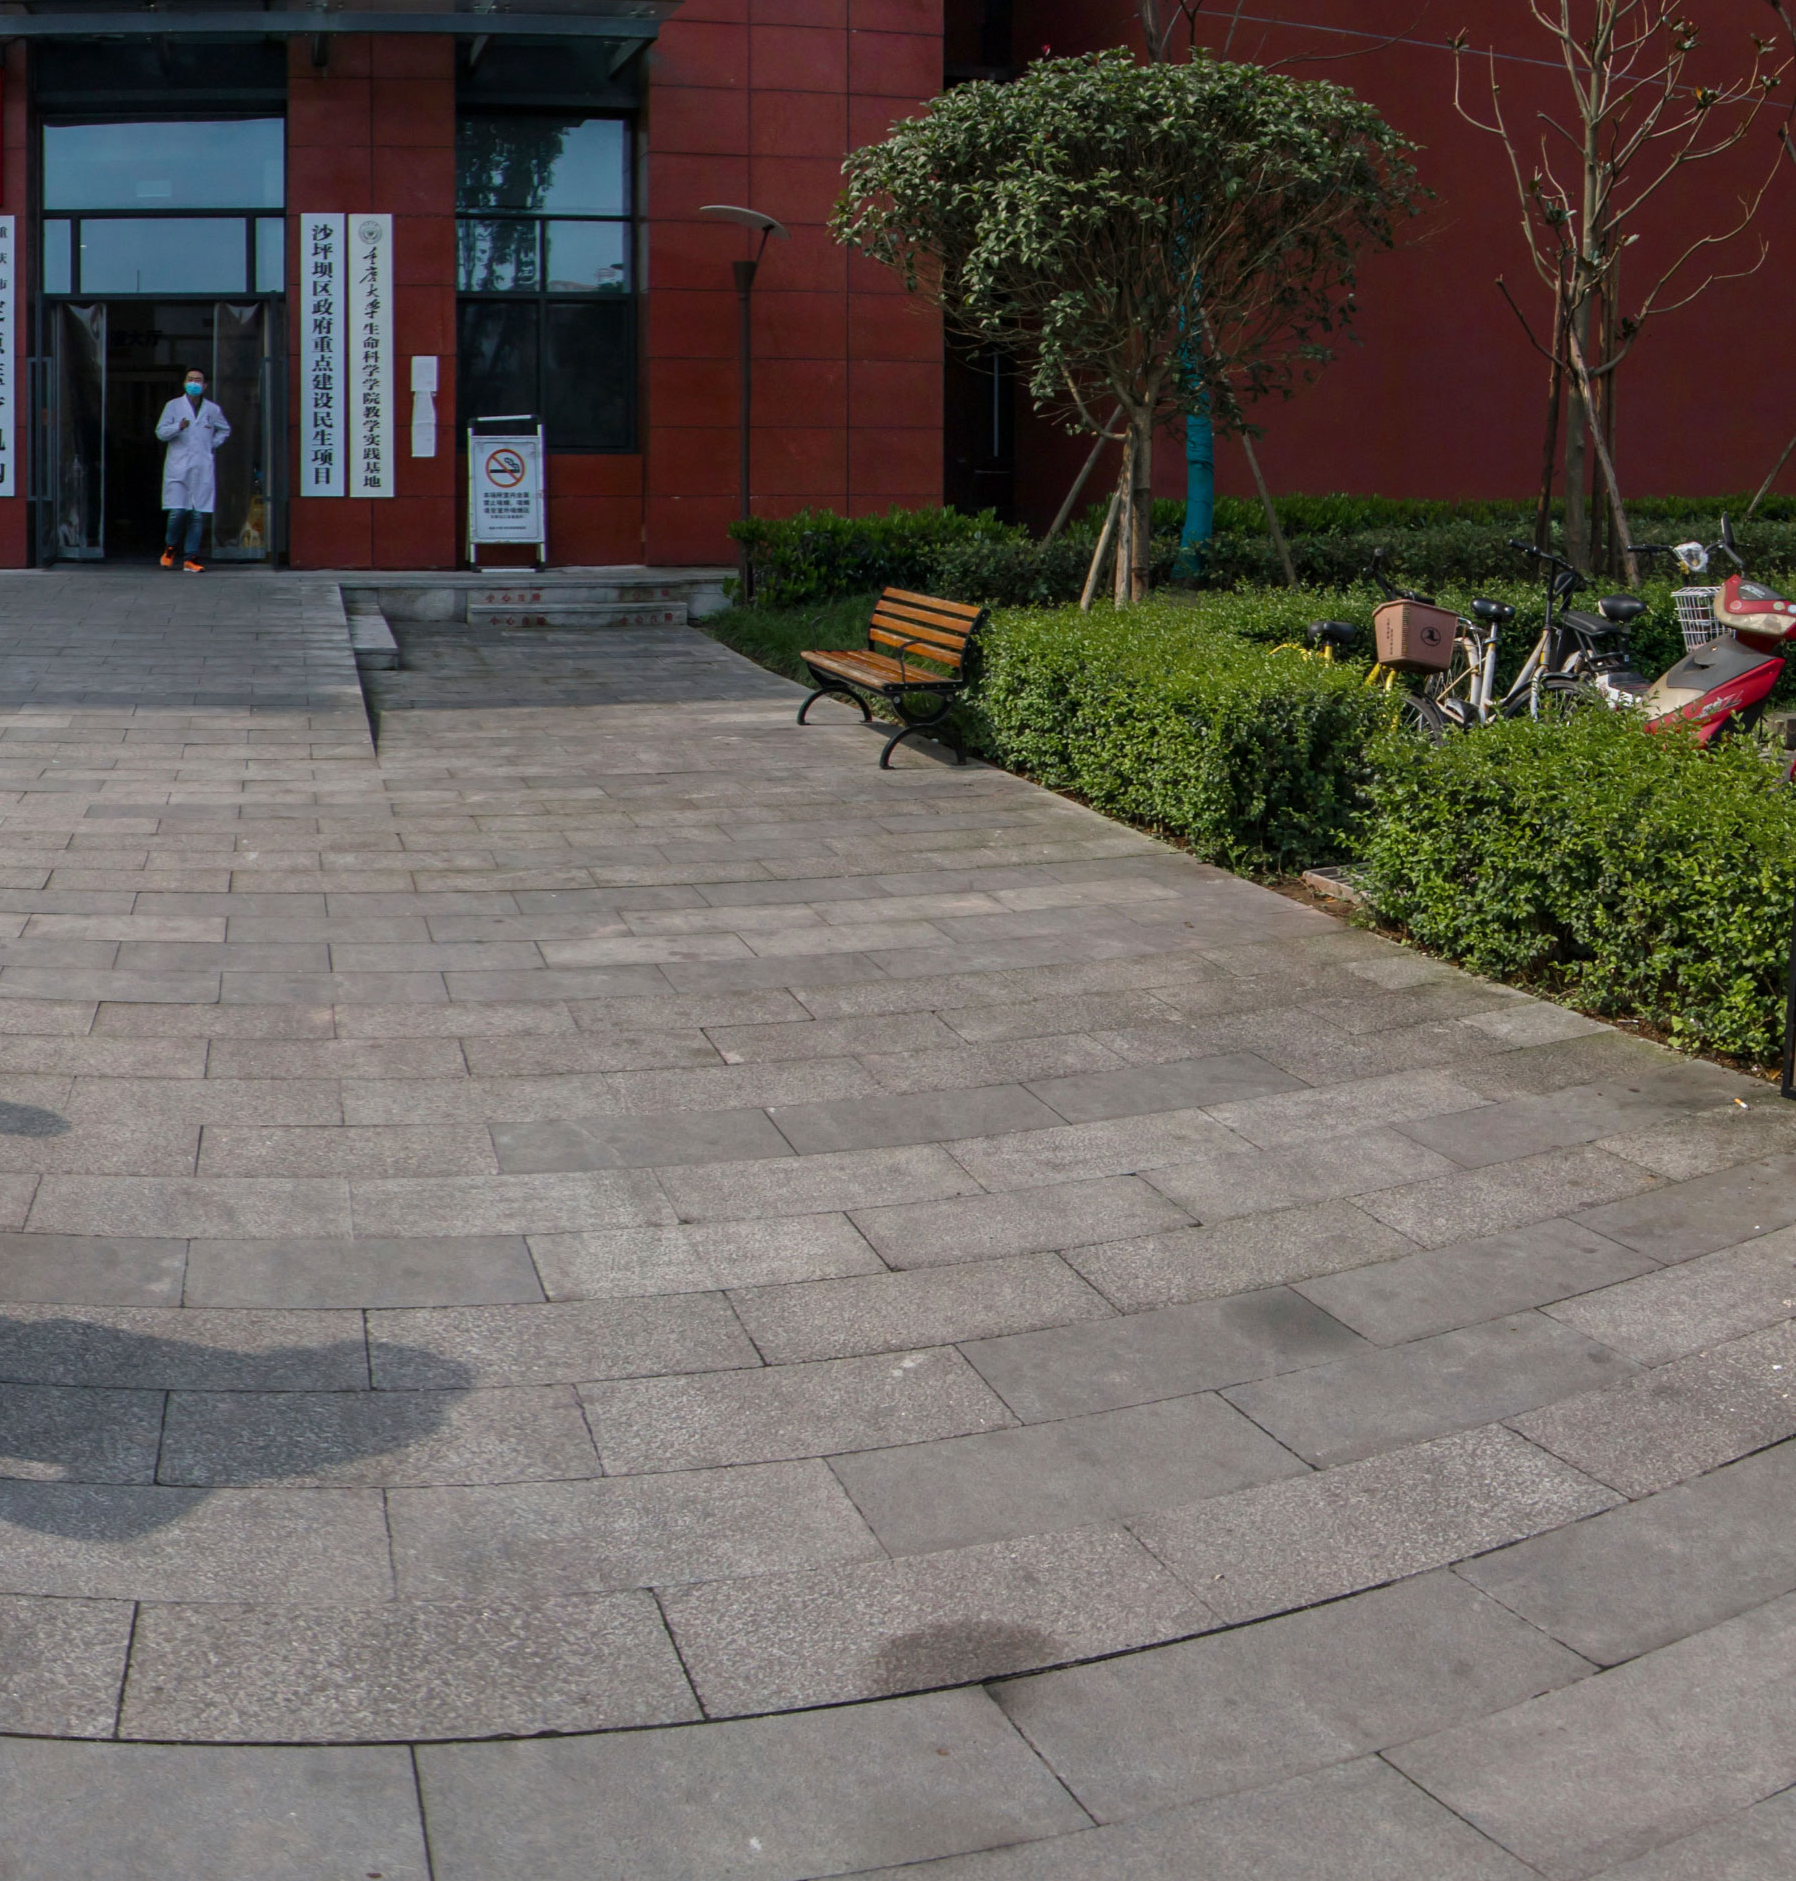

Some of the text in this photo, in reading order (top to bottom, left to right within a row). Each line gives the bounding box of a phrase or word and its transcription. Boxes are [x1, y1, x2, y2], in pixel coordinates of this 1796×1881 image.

[311, 224, 334, 485] 沙坪坝区政府重点建设民生项目
